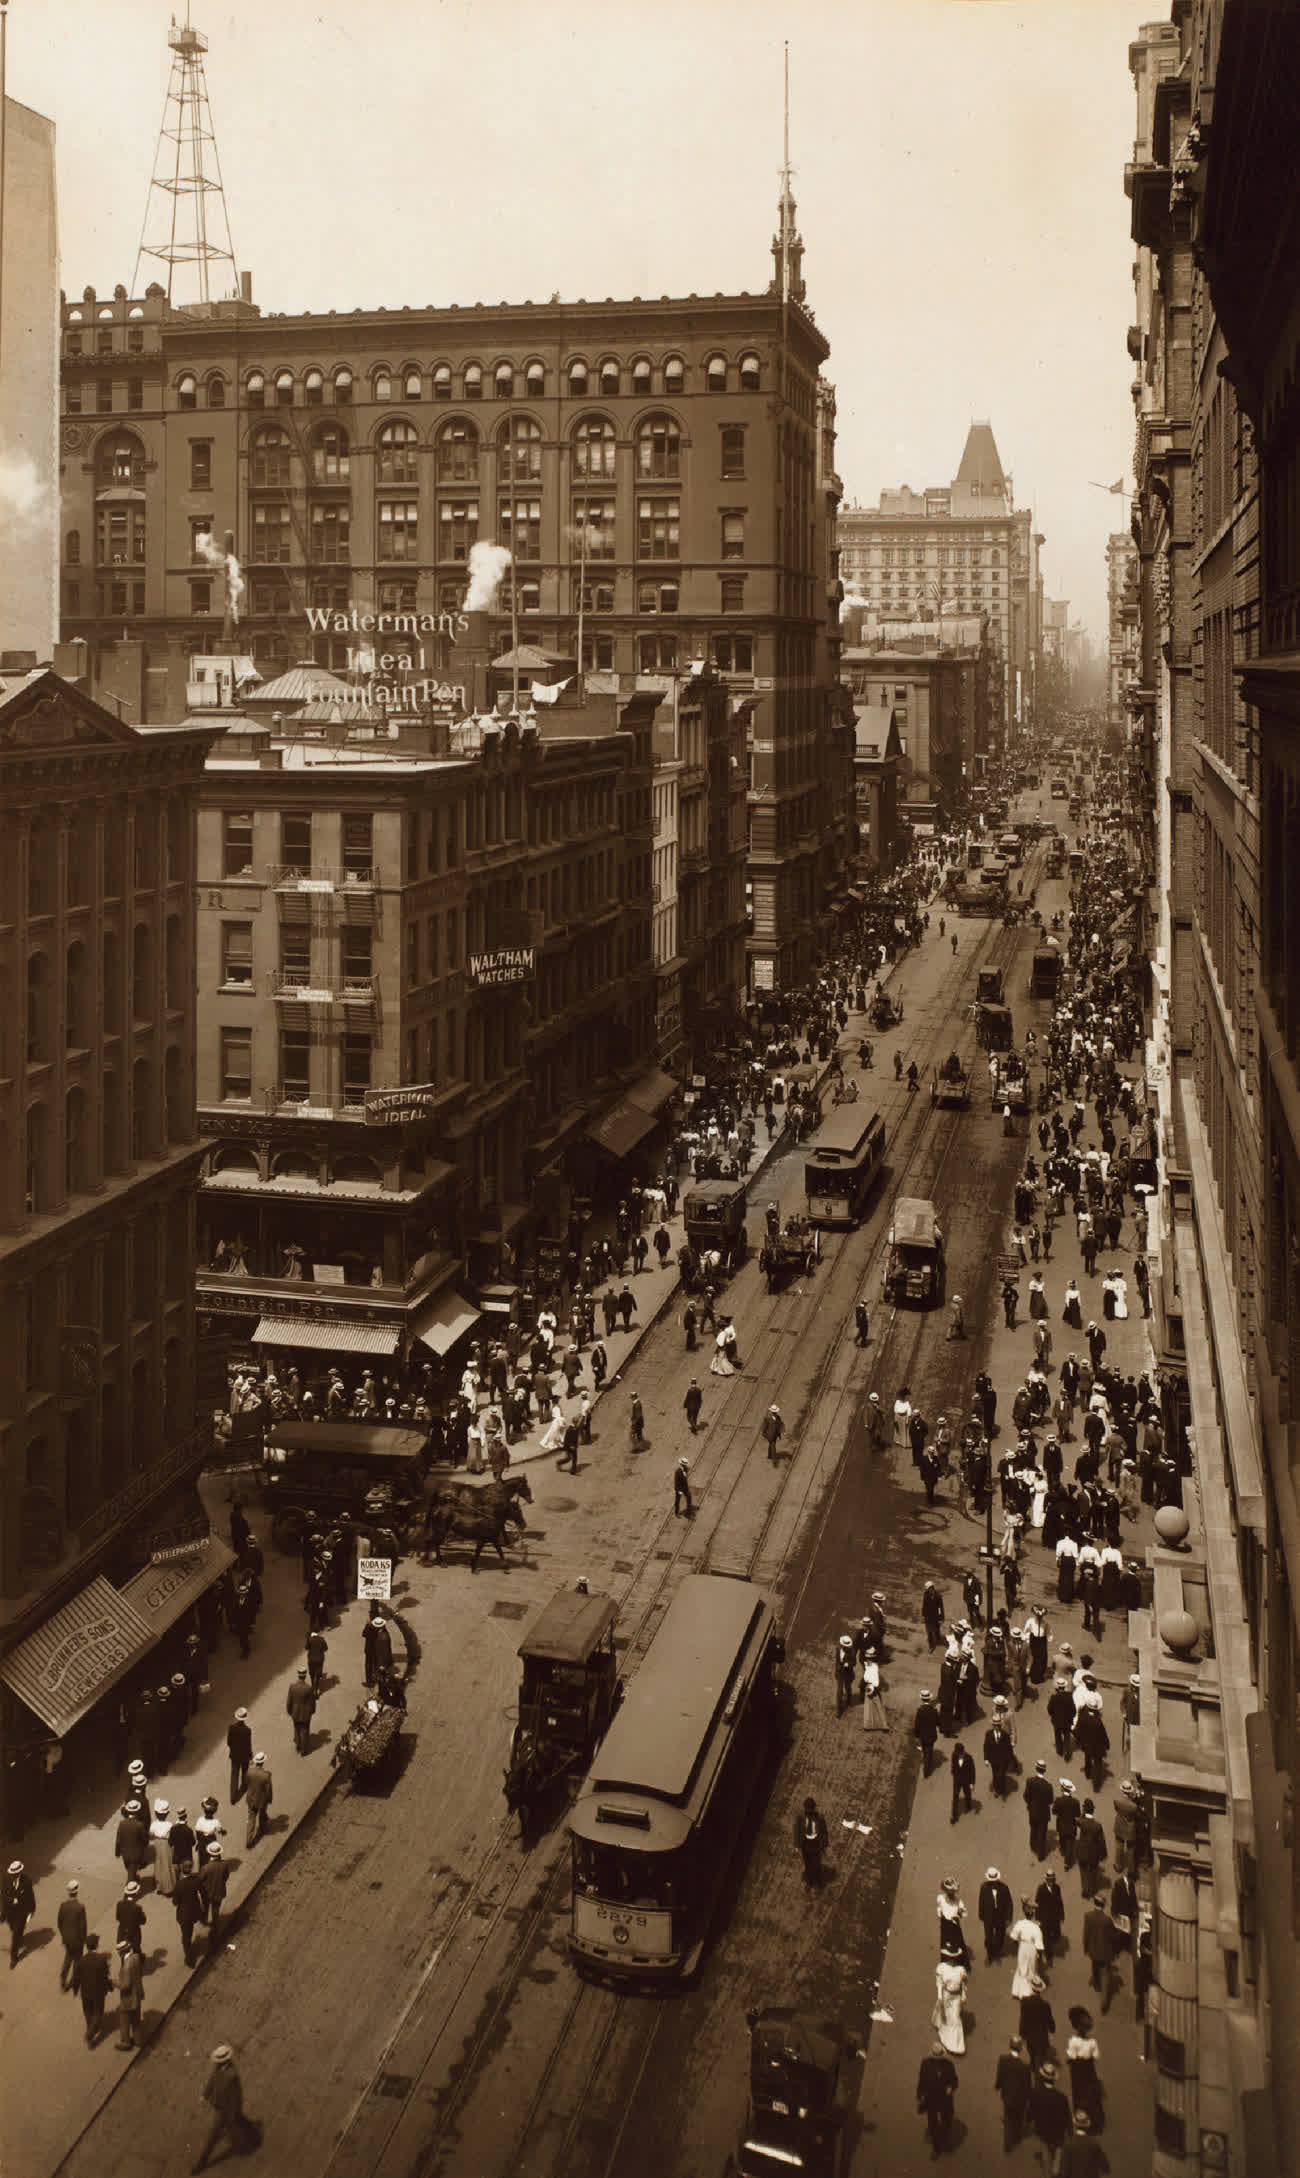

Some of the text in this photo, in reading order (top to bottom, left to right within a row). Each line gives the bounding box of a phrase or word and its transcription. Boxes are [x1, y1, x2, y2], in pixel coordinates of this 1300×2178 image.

[304, 607, 470, 642] Waterman's
[346, 647, 425, 671] Ideal
[304, 679, 468, 713] Fountain Pen
[470, 949, 533, 976] WALTHAM
[477, 967, 525, 985] WATCHES
[385, 1108, 427, 1123] IDEAL
[360, 1560, 391, 1569] KODAKS
[145, 1555, 208, 1608] CIGARS
[87, 1619, 116, 1640] SONS
[73, 1649, 125, 1702] JEWELERS
